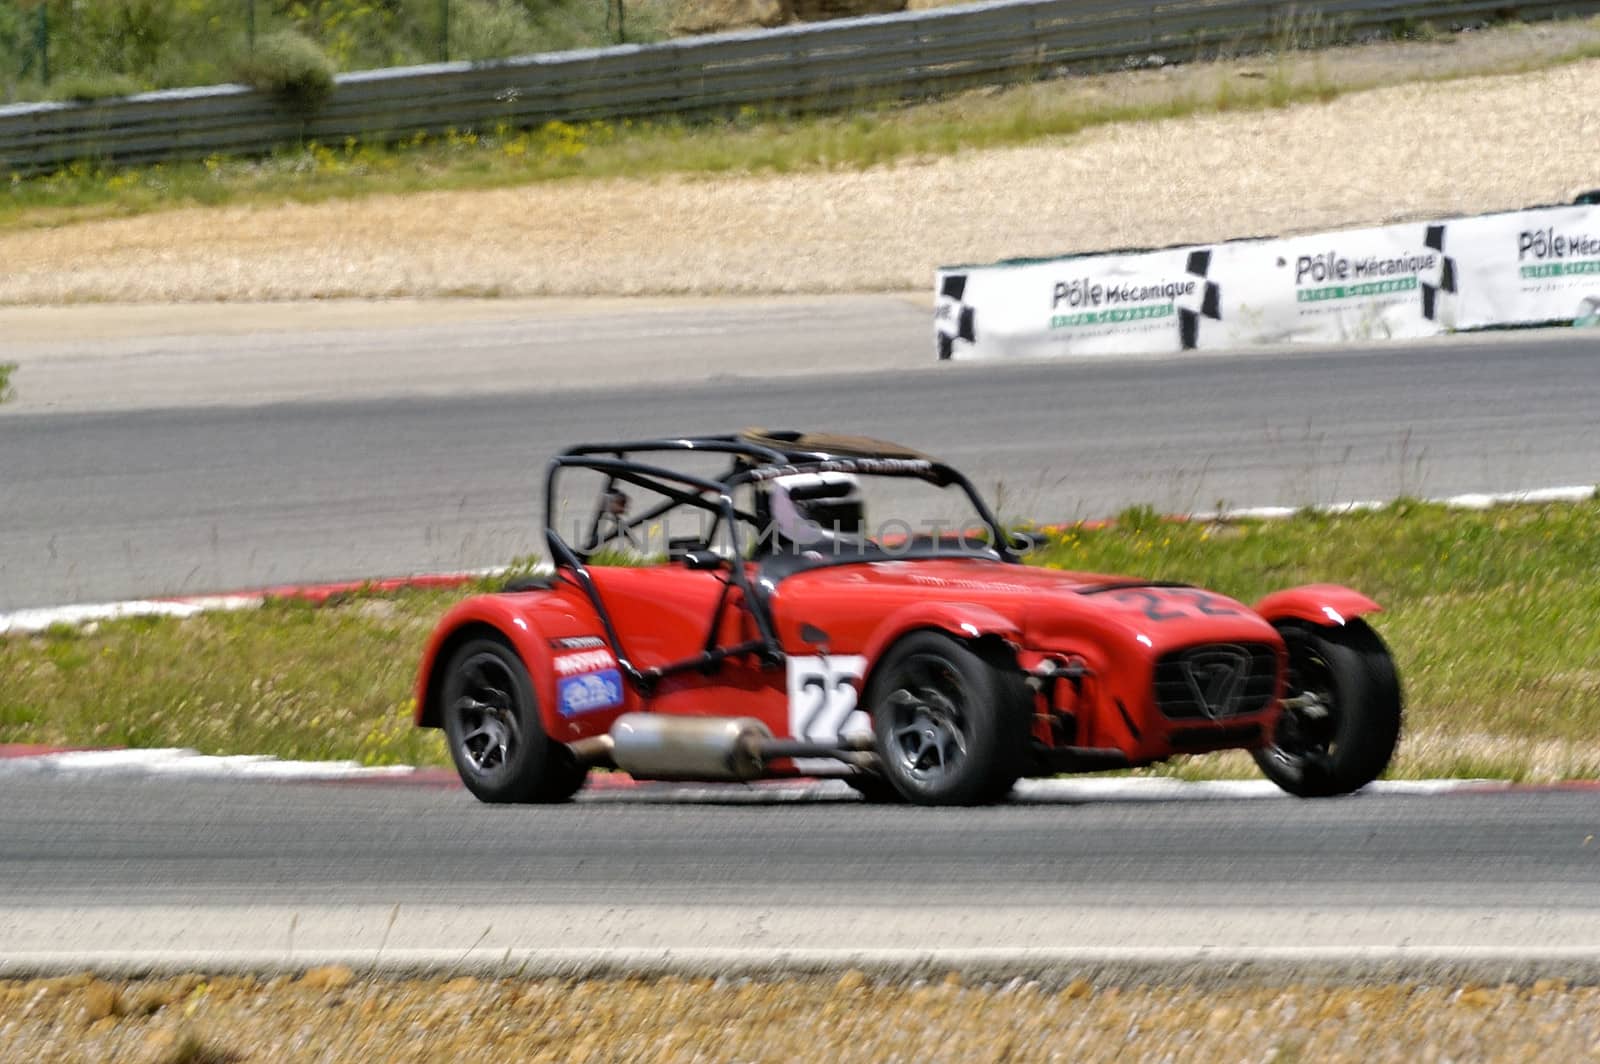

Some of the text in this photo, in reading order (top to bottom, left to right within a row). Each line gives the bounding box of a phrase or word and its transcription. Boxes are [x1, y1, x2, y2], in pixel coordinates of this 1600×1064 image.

[1518, 226, 1566, 261] Pôle
[1296, 250, 1435, 284] Pôle Mécanique
[1053, 277, 1196, 309] Pôle Mécanique
[801, 671, 862, 745] 22
